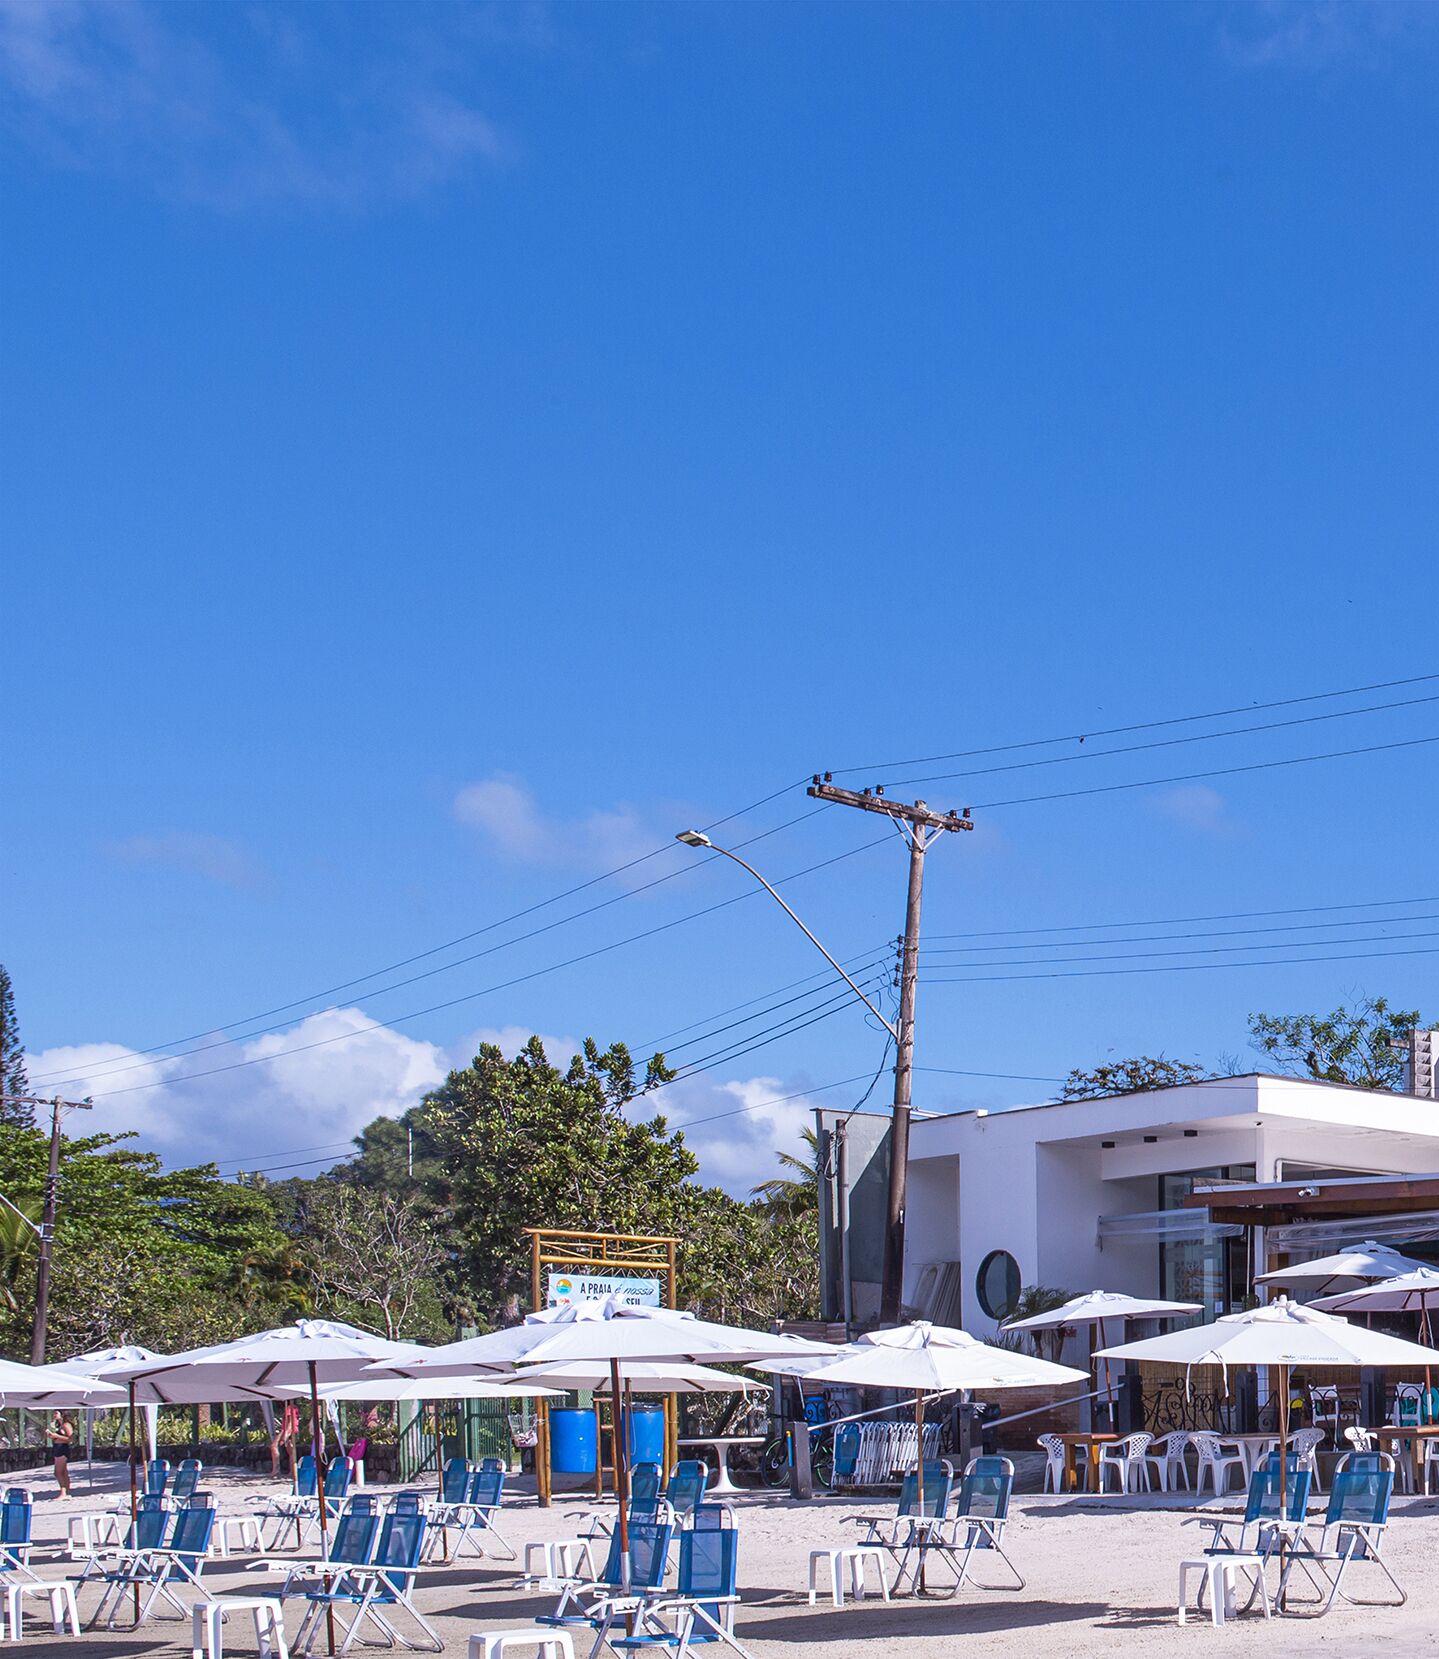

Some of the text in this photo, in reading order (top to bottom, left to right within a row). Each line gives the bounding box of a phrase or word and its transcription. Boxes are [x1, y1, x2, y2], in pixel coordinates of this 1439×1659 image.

[580, 1282, 654, 1296] A PRAIA é nossa
